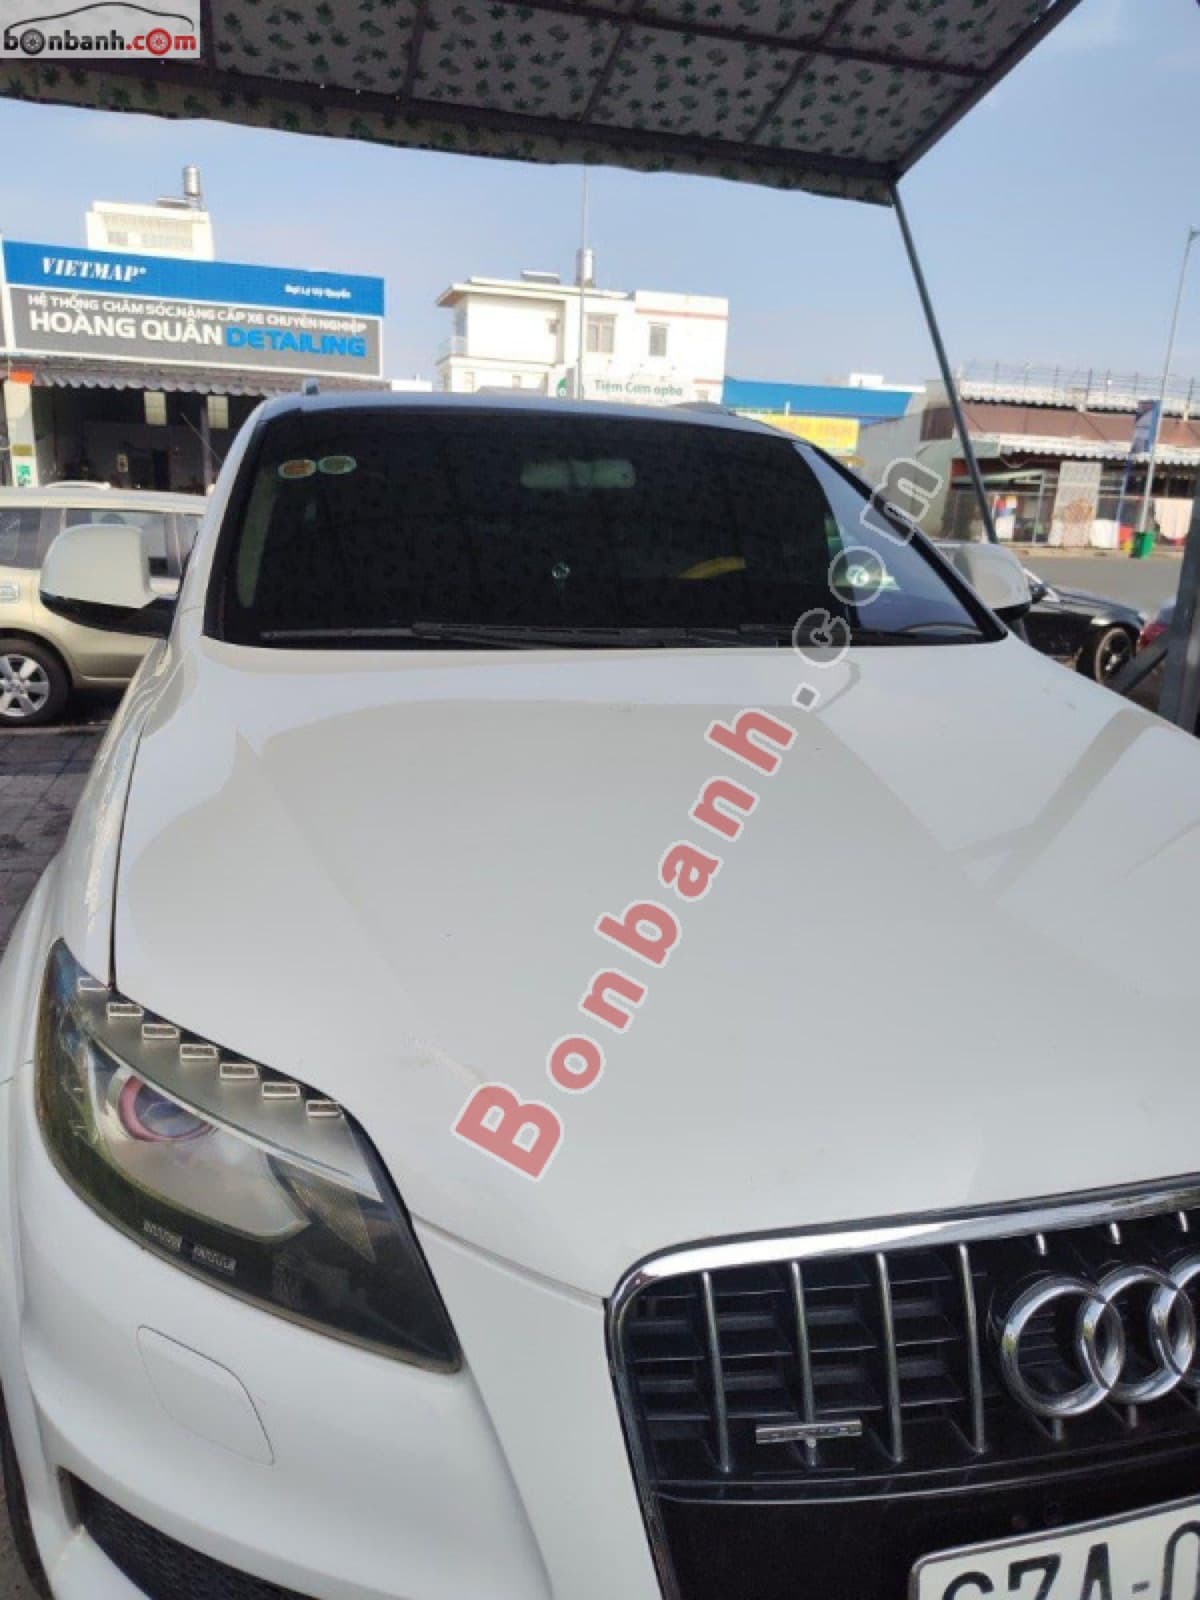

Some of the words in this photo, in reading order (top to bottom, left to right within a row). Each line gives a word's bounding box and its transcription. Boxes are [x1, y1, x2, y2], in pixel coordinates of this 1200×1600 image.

[29, 308, 137, 339] HOÀNG
[141, 316, 222, 345] QUÂN
[226, 327, 366, 357] DETAILING
